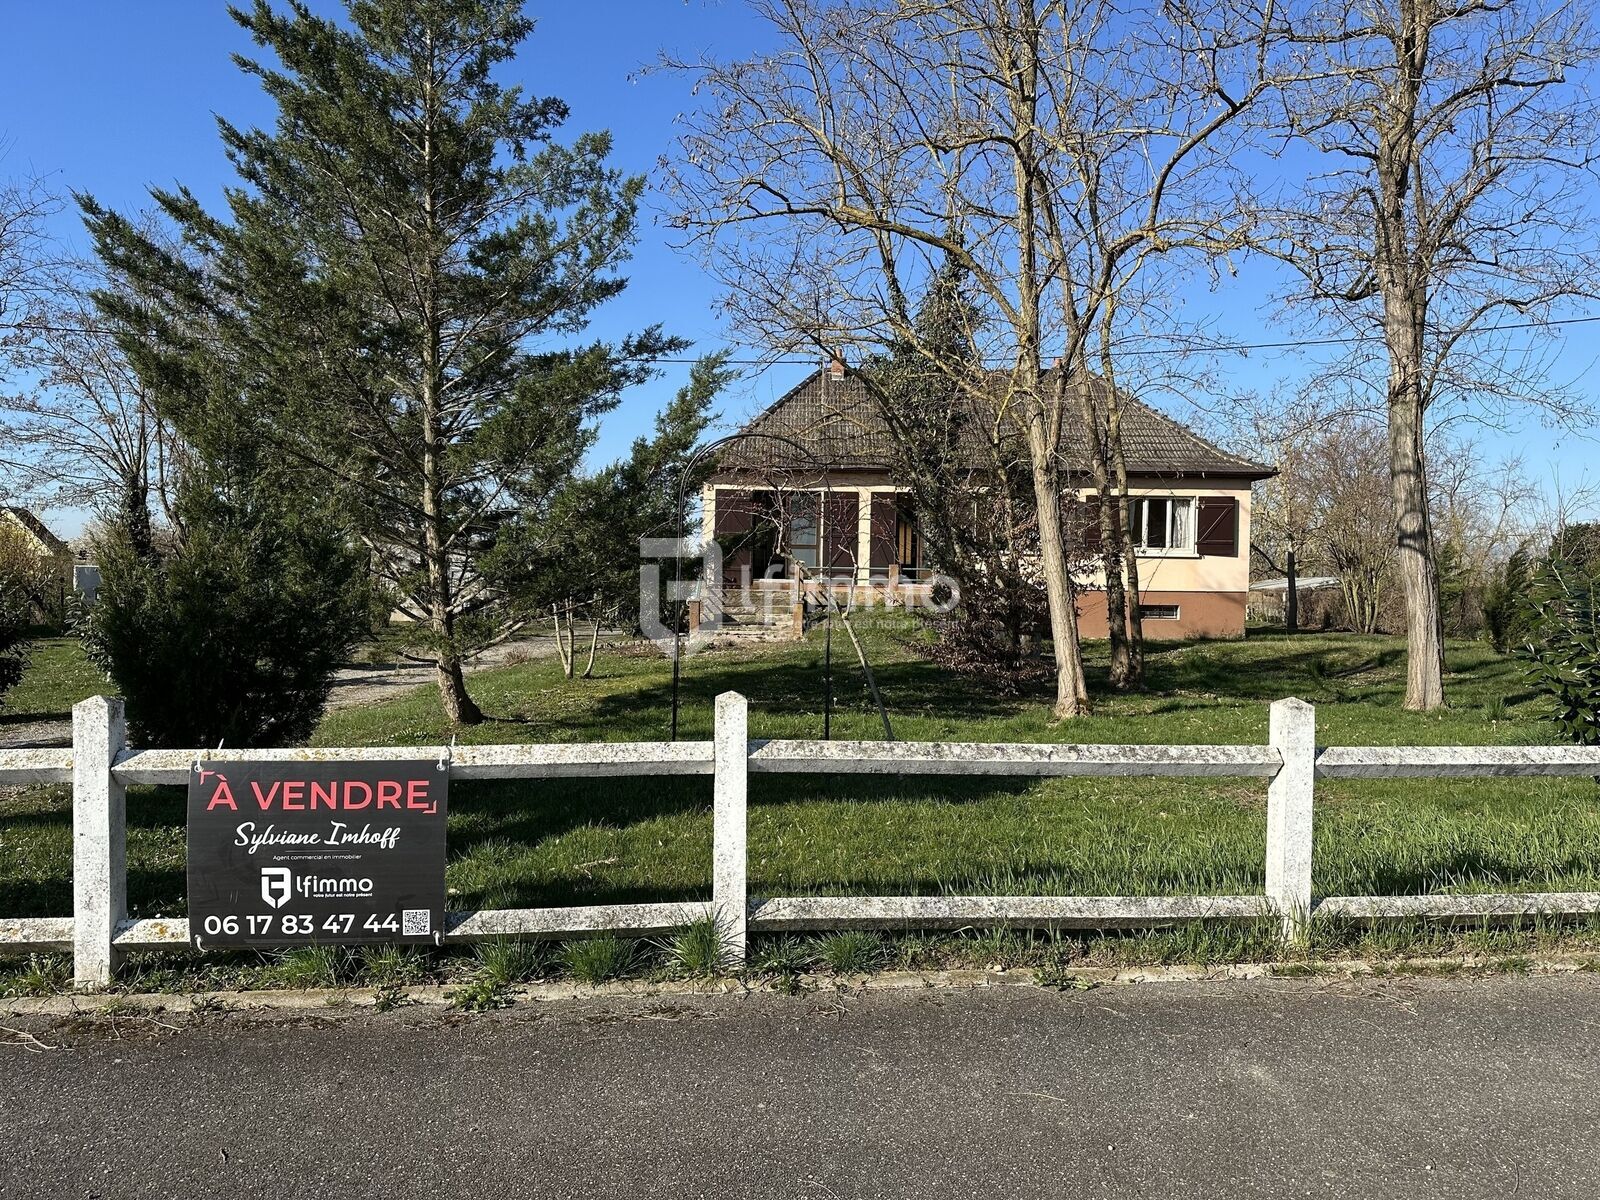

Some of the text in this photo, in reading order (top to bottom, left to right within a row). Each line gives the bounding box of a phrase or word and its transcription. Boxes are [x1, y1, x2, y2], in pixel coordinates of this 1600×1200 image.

[206, 774, 430, 811] À VENDRE
[234, 820, 401, 855] Sylviane Imhoff
[204, 913, 400, 935] 06 17 83 47 44
